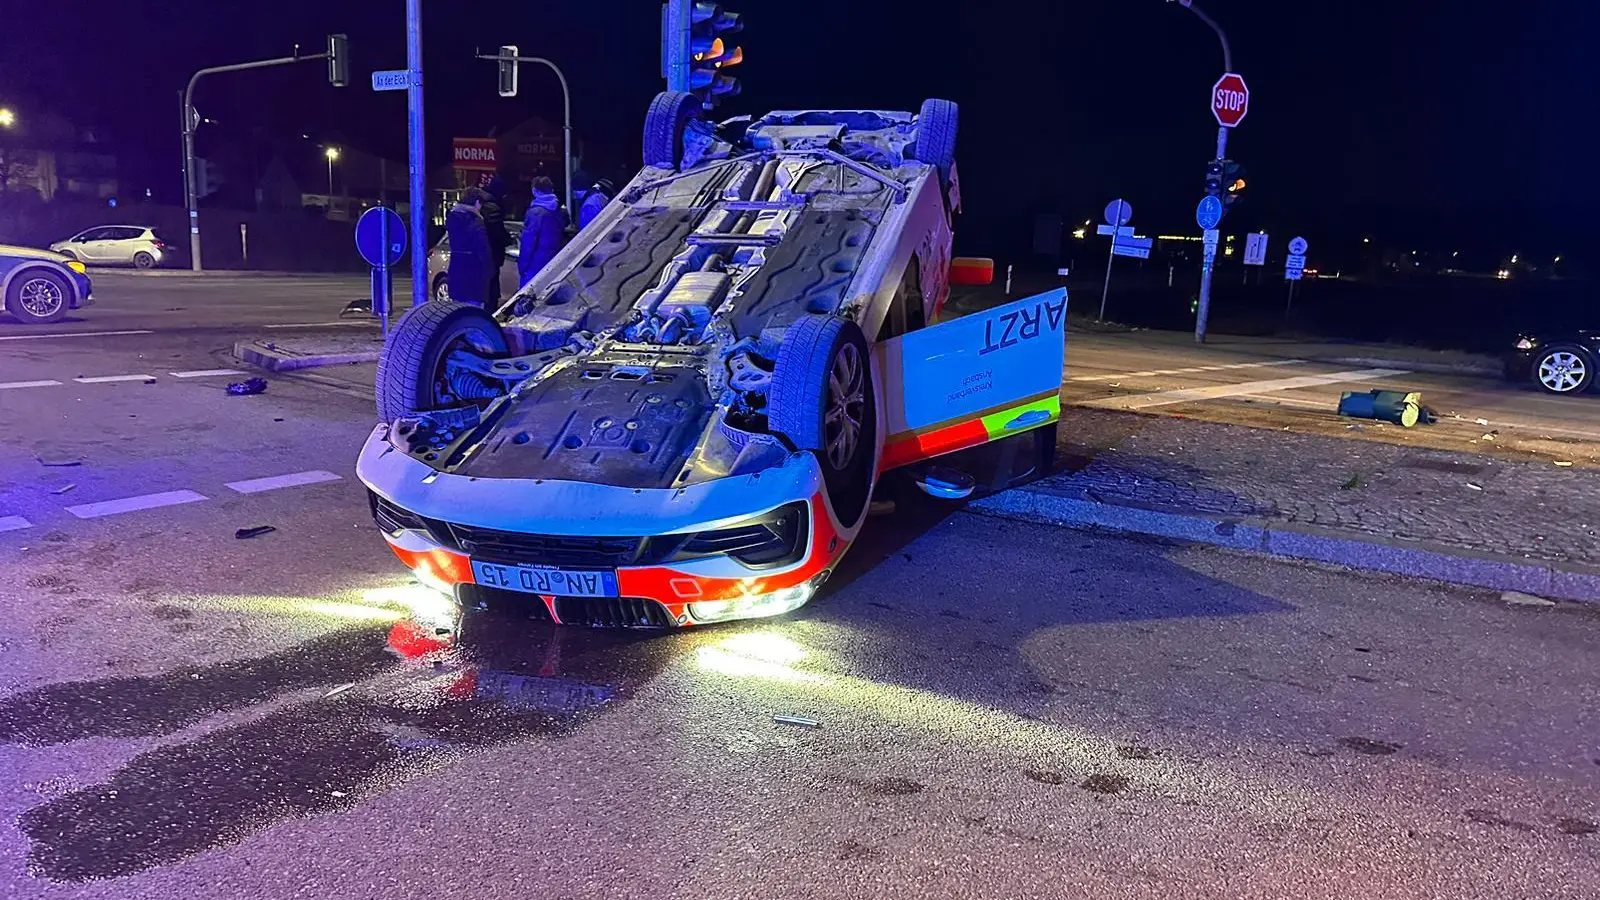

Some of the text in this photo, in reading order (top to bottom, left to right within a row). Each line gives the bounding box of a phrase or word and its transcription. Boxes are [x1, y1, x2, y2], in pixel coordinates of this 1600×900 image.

[376, 75, 385, 86] An
[385, 74, 394, 86] der
[1216, 88, 1245, 111] STOP
[454, 147, 496, 161] NORMA
[517, 143, 556, 154] NORMA
[978, 296, 1068, 355] ARZT
[962, 368, 993, 386] Ansbach
[481, 564, 510, 587] 15
[519, 569, 550, 592] RD
[565, 573, 598, 595] AN
